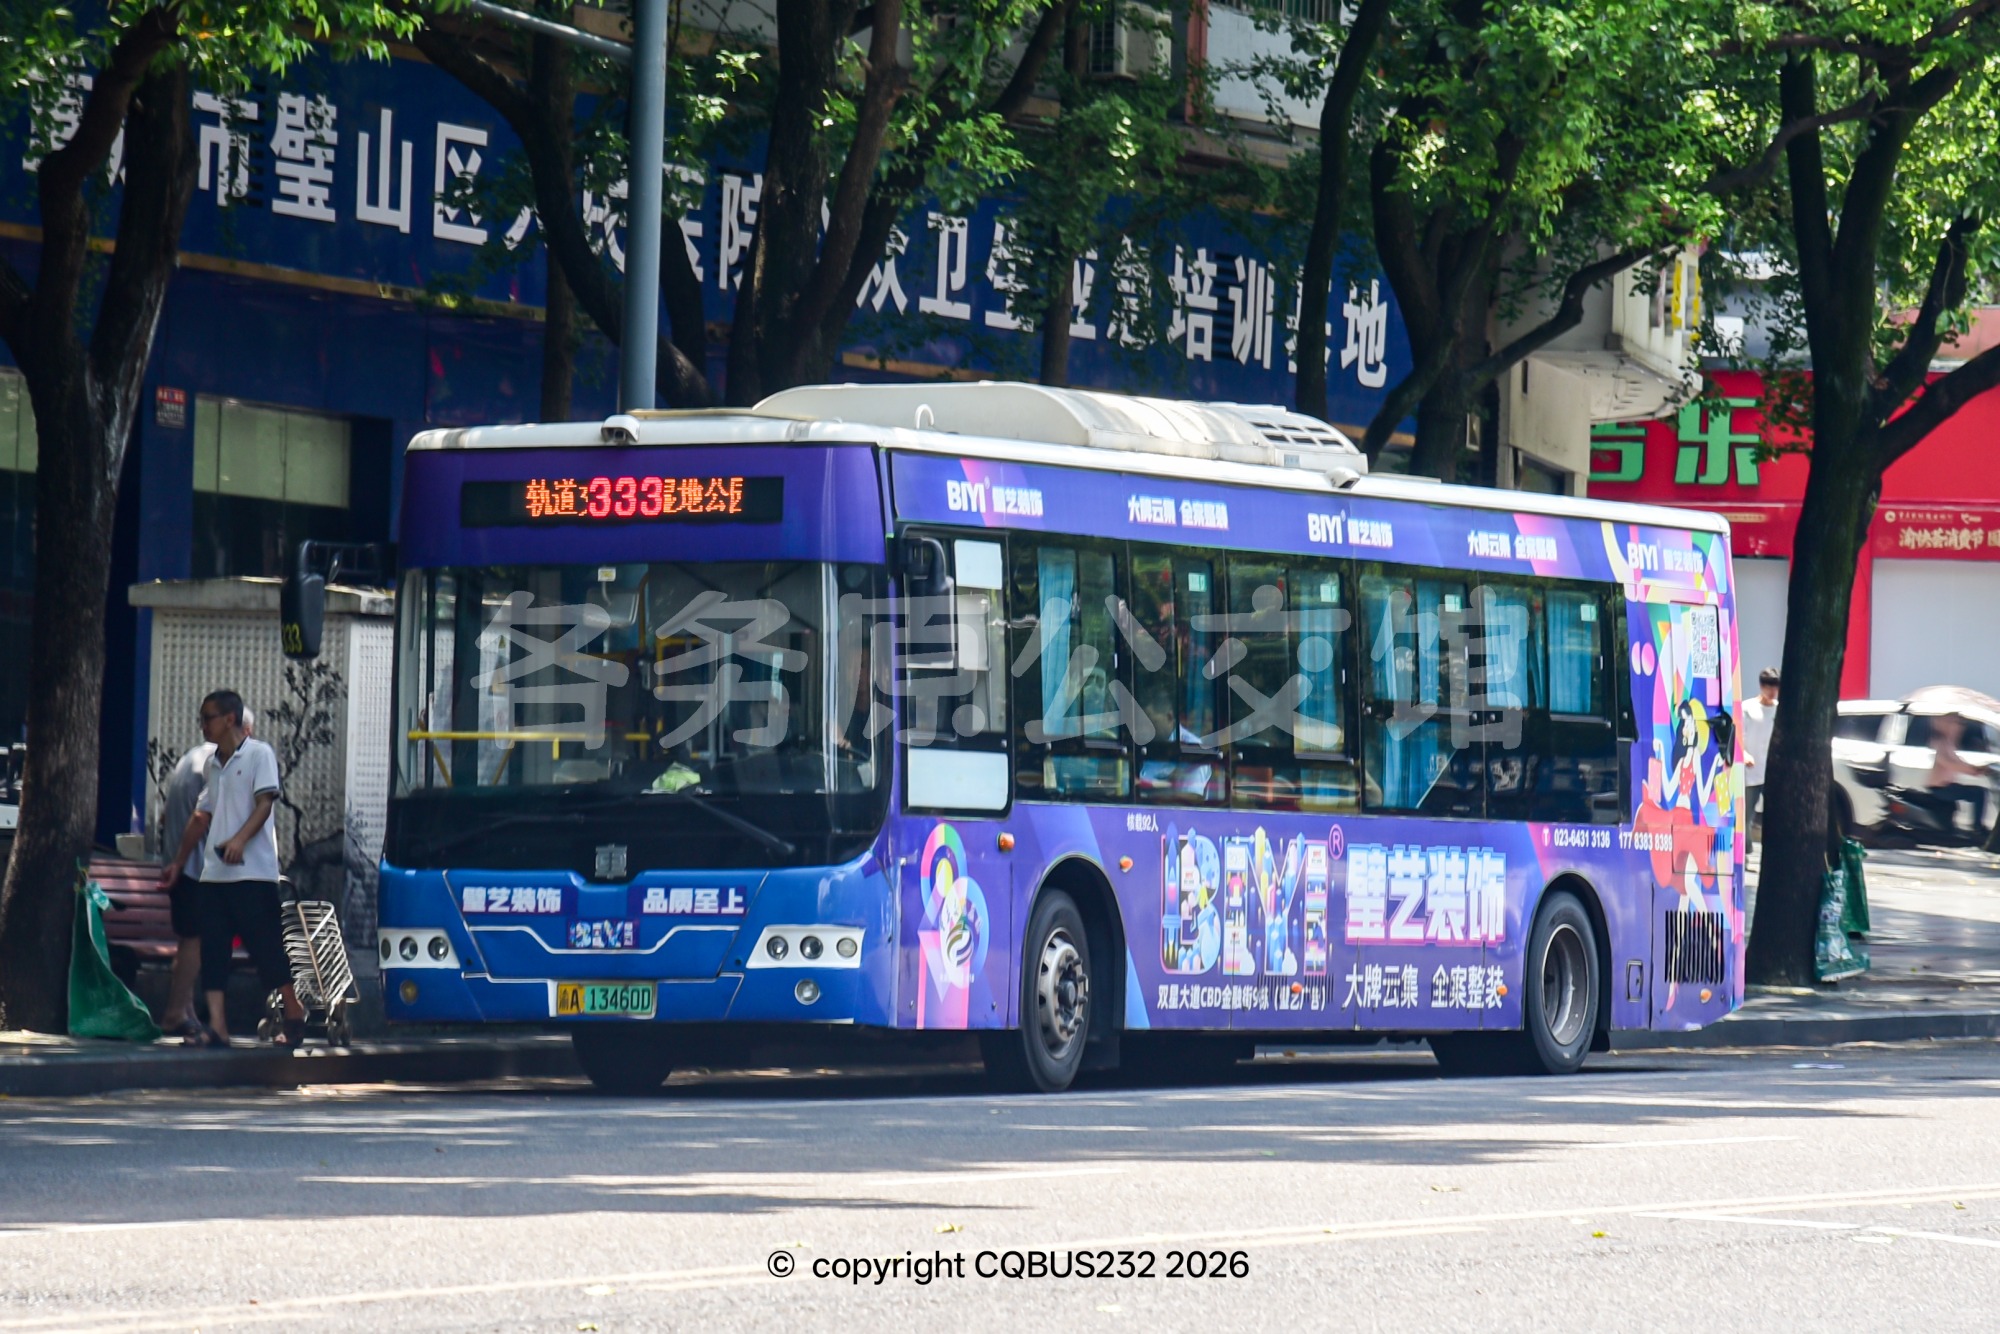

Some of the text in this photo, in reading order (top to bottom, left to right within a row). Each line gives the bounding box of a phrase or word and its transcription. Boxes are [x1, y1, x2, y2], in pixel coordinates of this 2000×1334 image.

[588, 476, 663, 518] 333
[461, 887, 562, 914] 璧艺装饰
[642, 888, 745, 914] 品质至上
[1345, 842, 1507, 946] 璧艺装饰
[1343, 963, 1504, 1009] 大牌云集 全案整装
